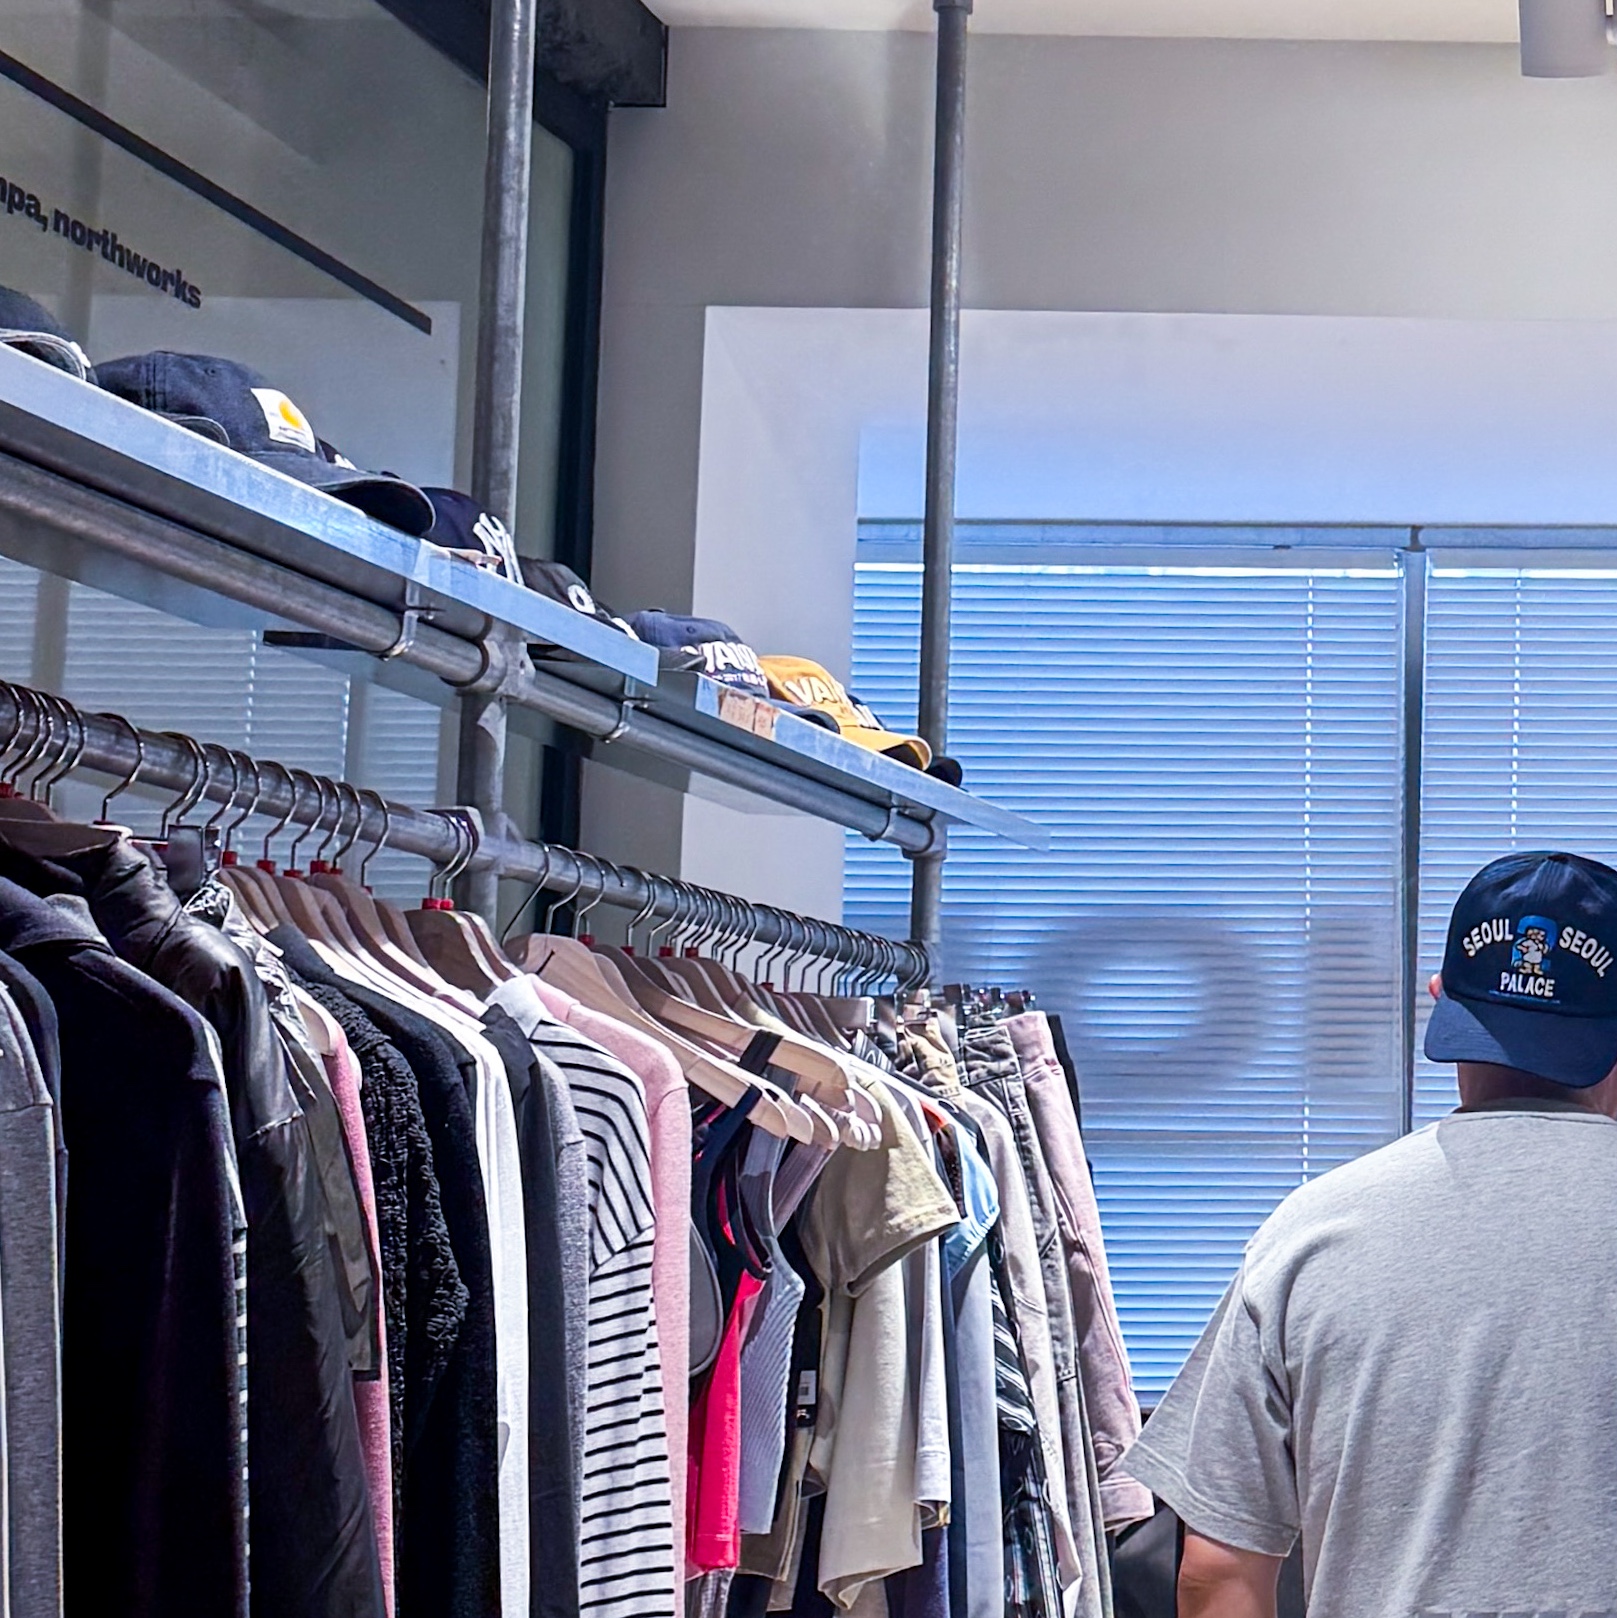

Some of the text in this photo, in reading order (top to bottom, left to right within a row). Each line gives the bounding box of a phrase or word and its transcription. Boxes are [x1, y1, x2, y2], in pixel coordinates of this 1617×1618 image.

[53, 208, 202, 309] northworks
[1462, 918, 1614, 978] SEOUL SEOUL
[1500, 971, 1555, 998] PALACE
